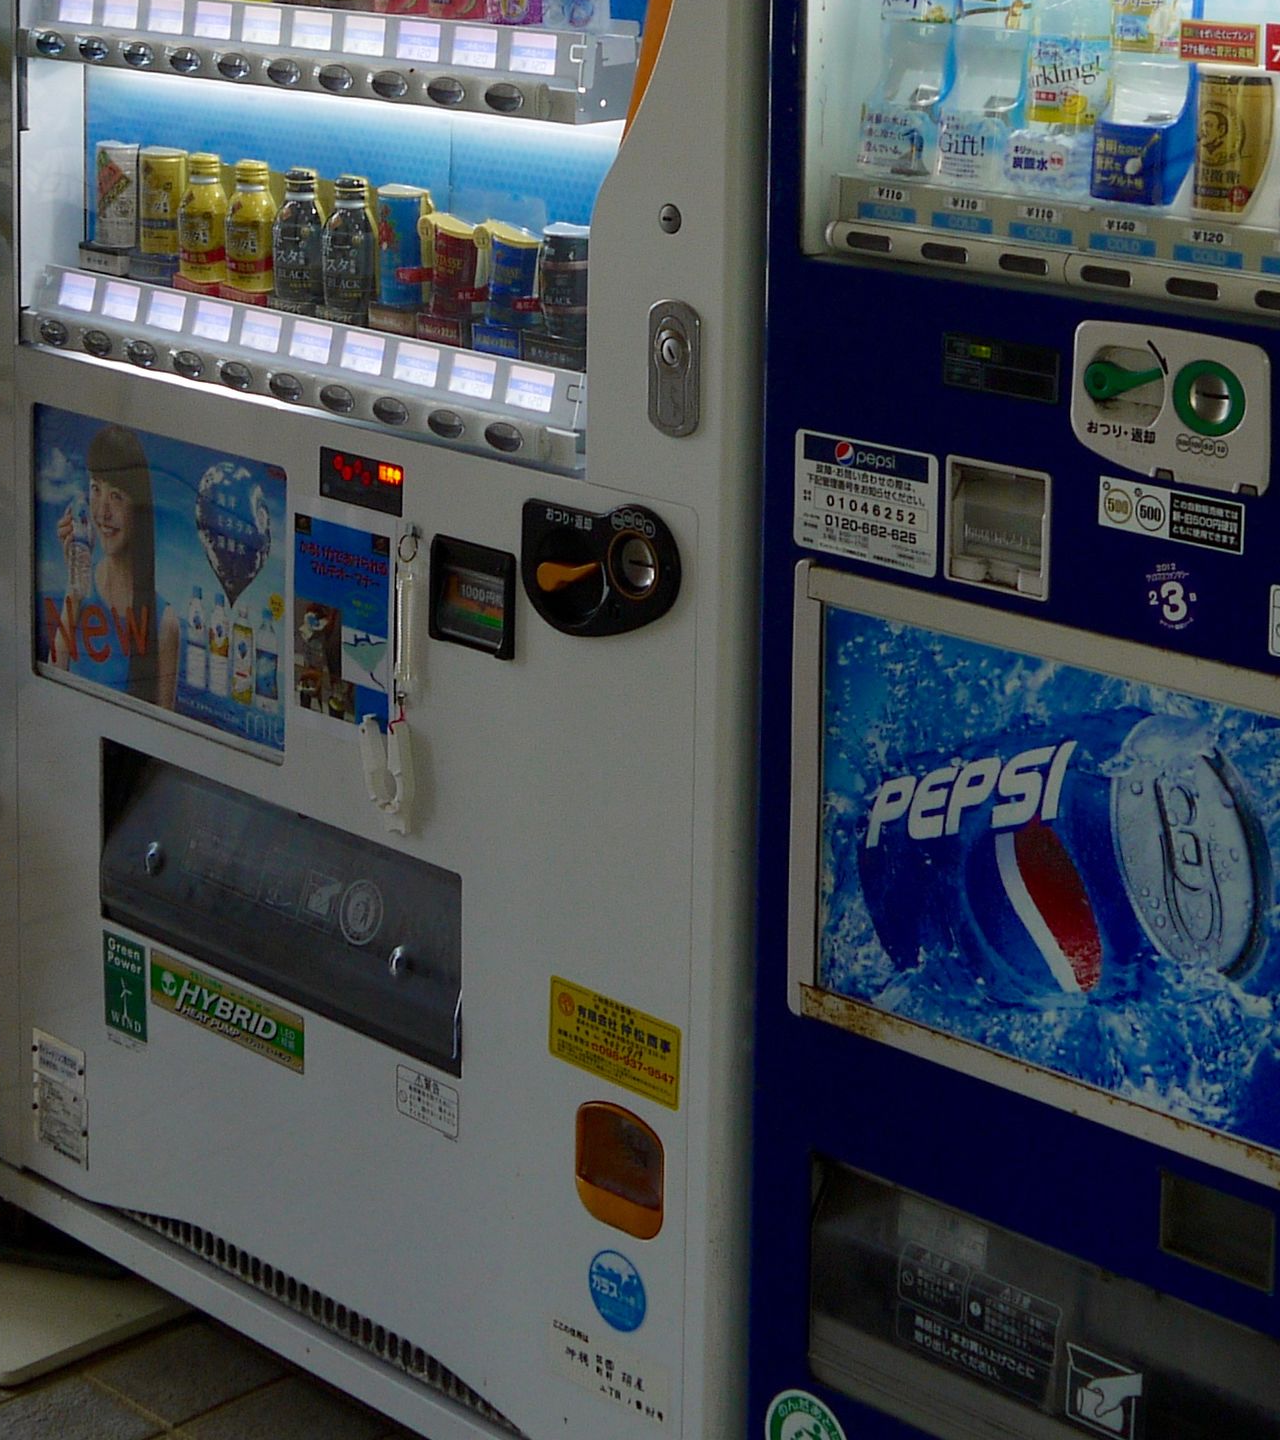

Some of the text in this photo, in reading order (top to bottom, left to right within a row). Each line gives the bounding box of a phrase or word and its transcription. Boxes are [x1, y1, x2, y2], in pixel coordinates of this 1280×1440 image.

[939, 130, 986, 157] Gift!
[1012, 156, 1049, 172] 炭酸水
[878, 187, 903, 201] ¥110
[952, 197, 978, 210] ¥110
[1027, 207, 1054, 220] ¥110
[1107, 219, 1136, 232] ¥140
[1193, 230, 1224, 244] ¥120
[277, 267, 310, 279] BLACK
[327, 276, 362, 289] BLACK
[1087, 420, 1157, 445] おつり・返却
[856, 450, 897, 470] pepsi
[807, 472, 926, 507] 下記管理番号をお知らせください。
[815, 463, 917, 493] 故障・お問い合わせの際は、
[826, 494, 917, 525] 01046252
[1107, 497, 1162, 523] 500 500
[824, 514, 918, 545] 0120-662-625
[1160, 580, 1188, 623] 3
[43, 597, 149, 664] New
[864, 740, 1078, 849] PEPSI
[107, 937, 141, 961] Green
[106, 950, 144, 976] Power
[110, 1009, 143, 1034] WIND
[175, 979, 258, 1041] HYBRID
[180, 1006, 241, 1038] HEAT PUMP
[577, 1004, 618, 1032] 有限会社
